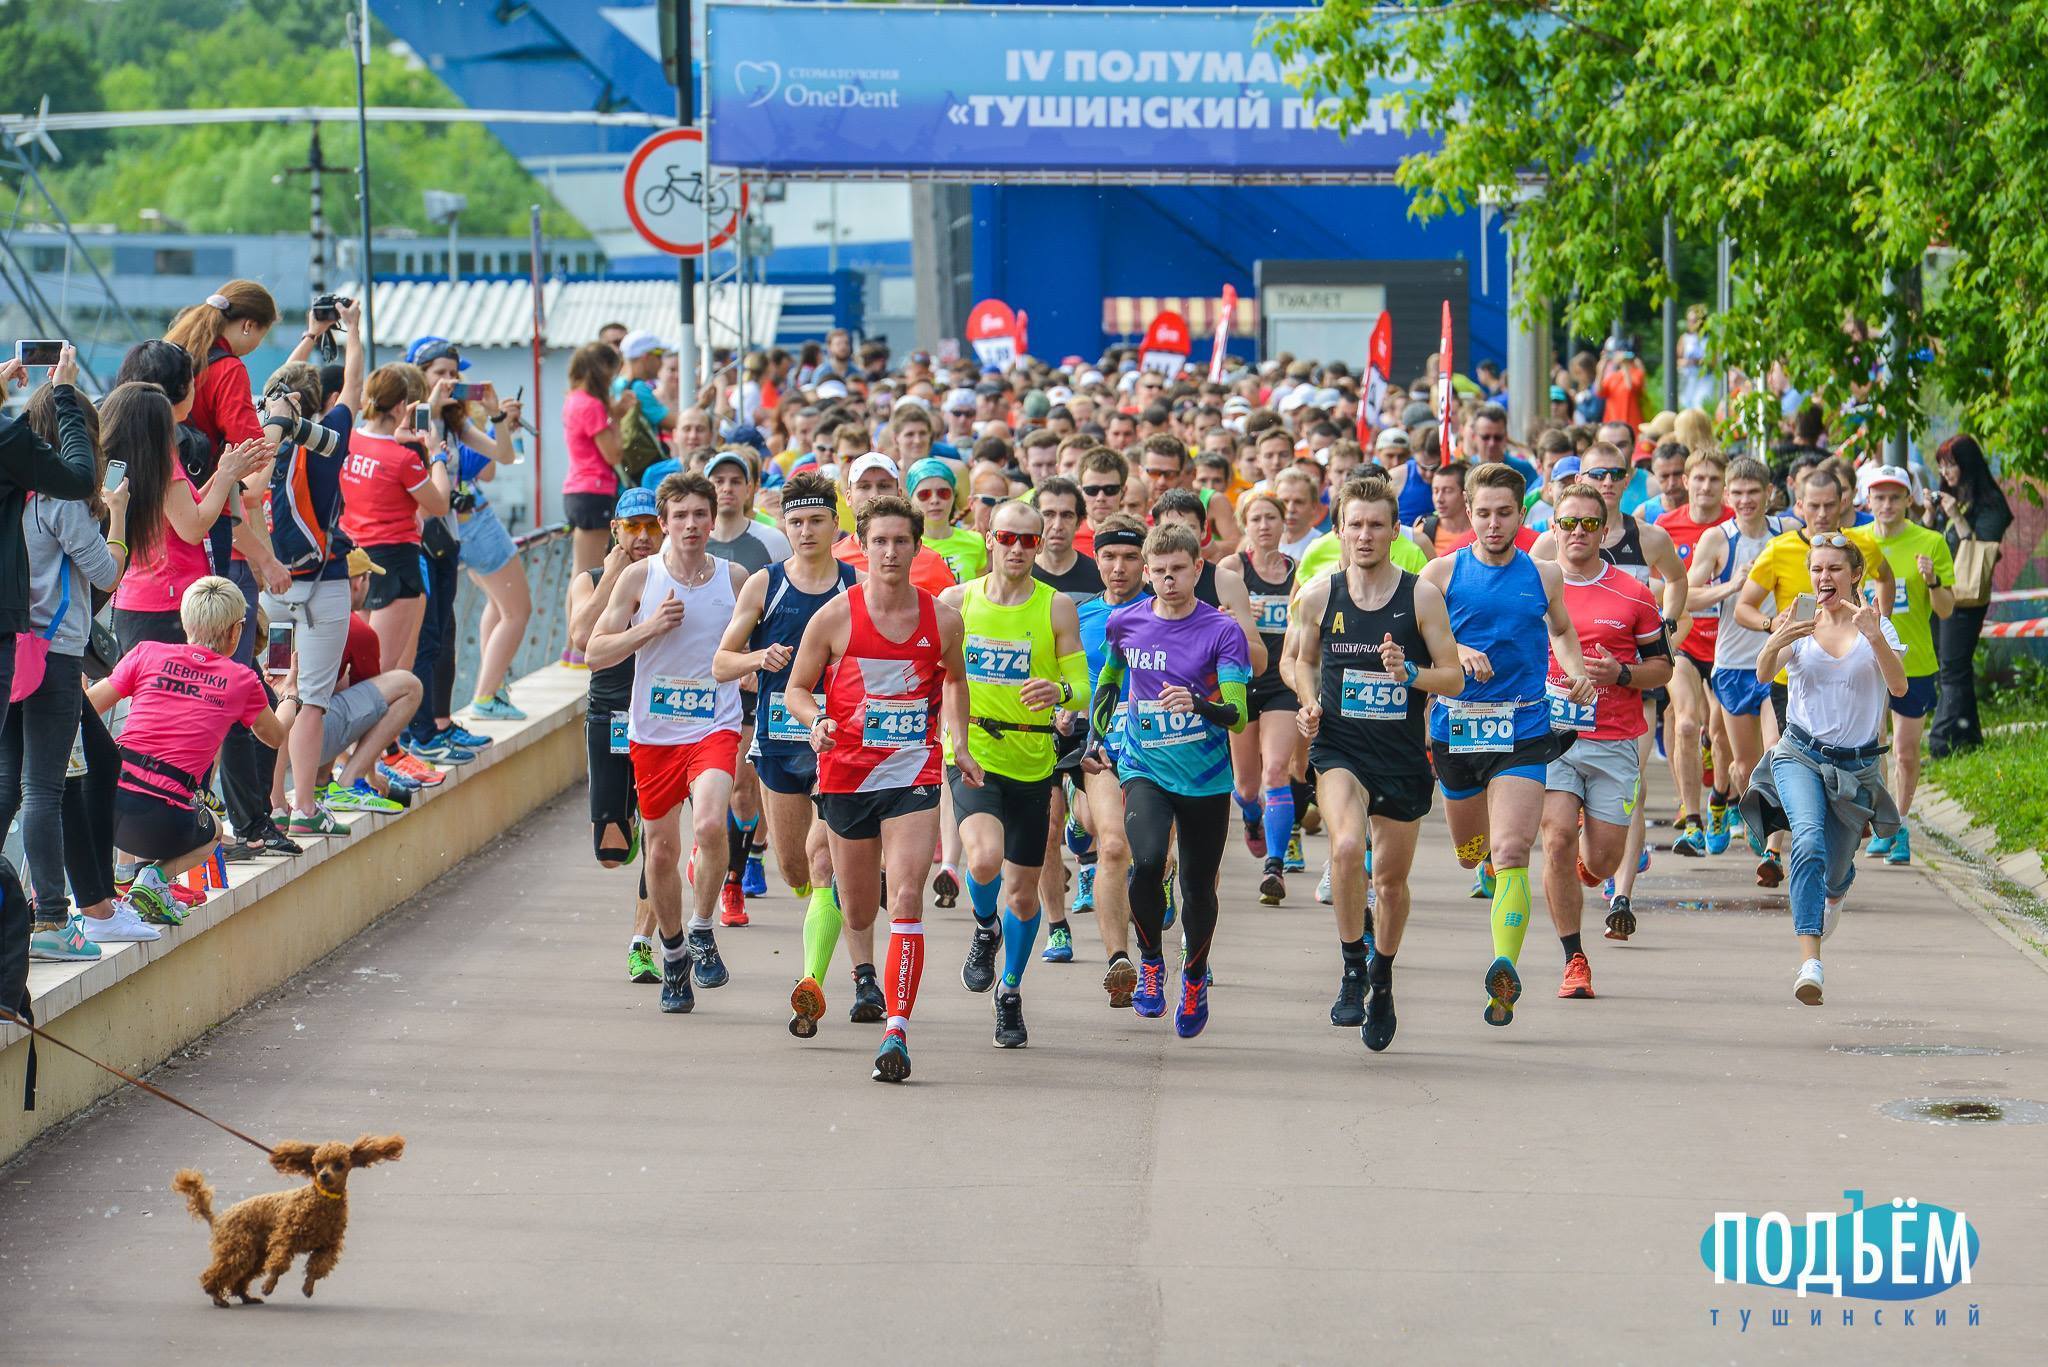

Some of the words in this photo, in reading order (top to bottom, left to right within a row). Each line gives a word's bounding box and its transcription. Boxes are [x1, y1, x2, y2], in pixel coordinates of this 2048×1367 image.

[1005, 49, 1055, 82] IV
[784, 83, 900, 108] OneDent
[948, 90, 1271, 129] «ТУШИНСКИЙ
[1277, 291, 1342, 308] ТУАЛЕТ
[350, 454, 380, 479] БЕГ
[785, 496, 825, 510] noname
[1264, 605, 1287, 623] 10
[1331, 611, 1345, 634] A
[980, 650, 1030, 673] 274
[1125, 647, 1167, 671] W&R
[161, 660, 228, 690] ДЕВОЧКИ
[150, 676, 203, 698] STAR
[1357, 685, 1408, 706] 450
[666, 691, 715, 711] 484
[1550, 698, 1595, 722] 512
[880, 713, 927, 734] 483
[1154, 712, 1203, 732] 102
[1467, 720, 1514, 739] 190
